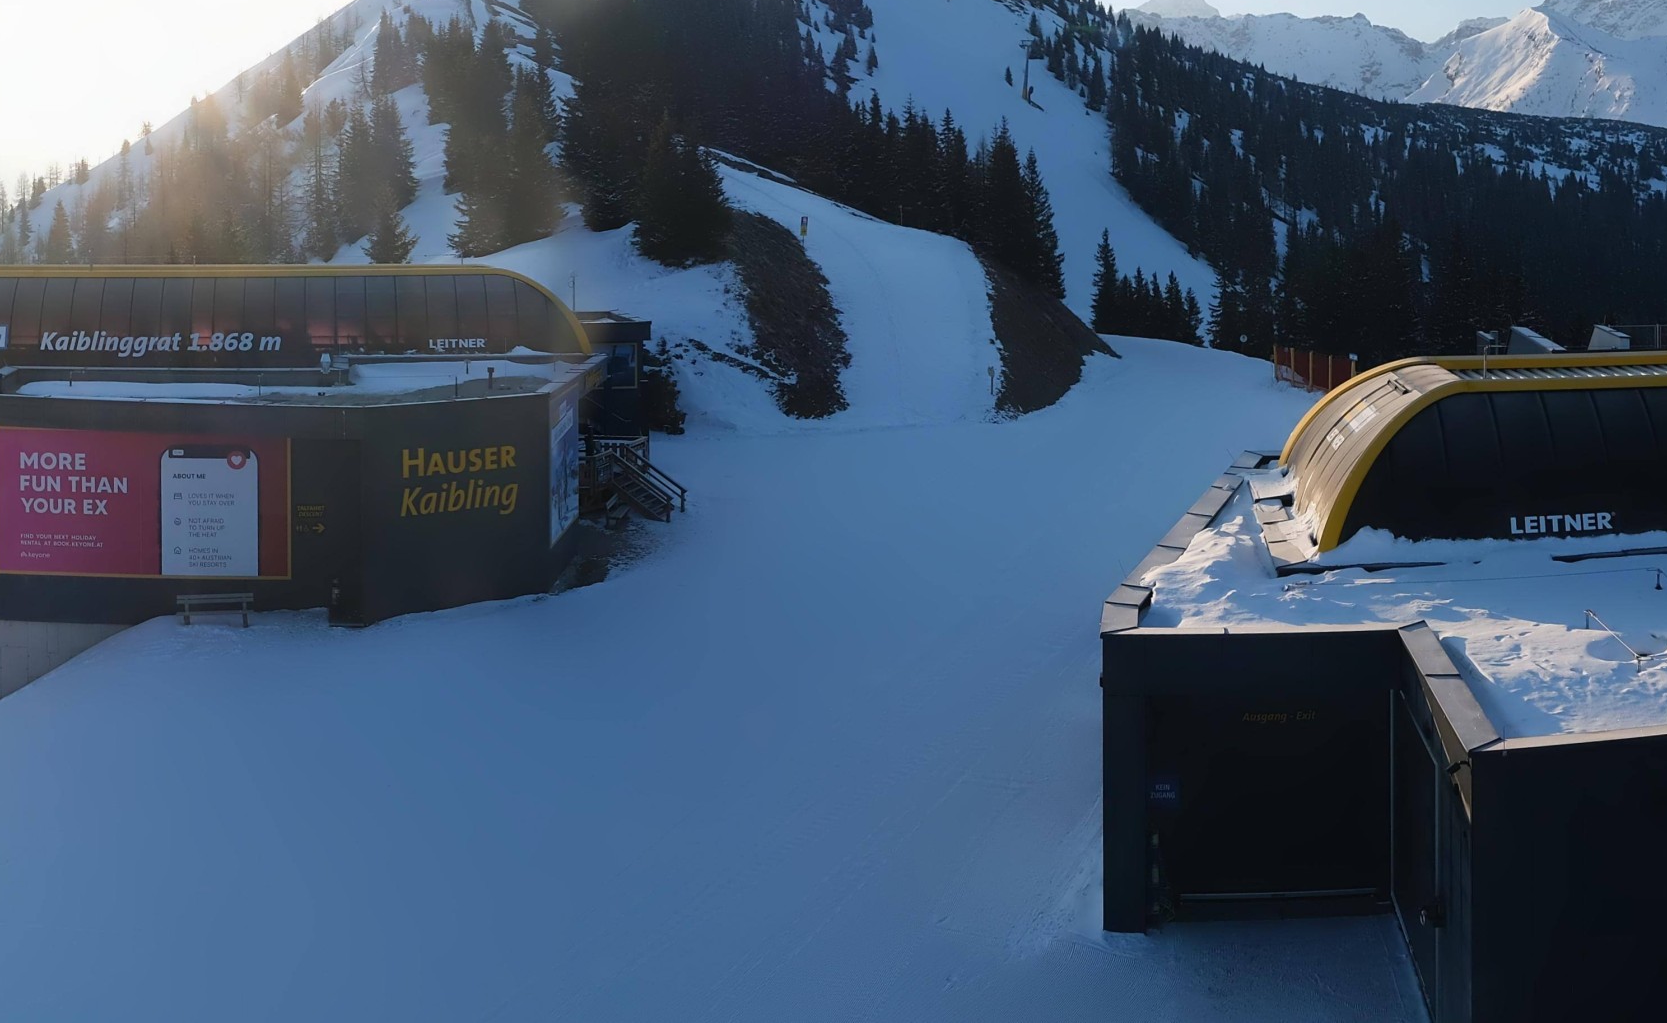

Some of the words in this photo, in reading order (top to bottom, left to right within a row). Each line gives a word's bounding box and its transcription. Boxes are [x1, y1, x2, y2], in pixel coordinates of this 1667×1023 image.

[40, 331, 181, 357] Kaiblinggrat
[187, 332, 253, 352] 1.868
[259, 335, 281, 352] m
[429, 338, 486, 349] LEITNER
[20, 452, 86, 470] MORE
[402, 445, 516, 478] HAUSER
[20, 475, 61, 492] FUN
[68, 476, 128, 494] THAN
[21, 497, 77, 515] YOUR
[83, 499, 109, 515] EX
[401, 479, 519, 517] Kaibling
[1510, 512, 1613, 534] LEITNER
[1242, 711, 1287, 724] Ausgang
[1296, 710, 1316, 720] Exit
[1150, 791, 1176, 799] ZUGANG
